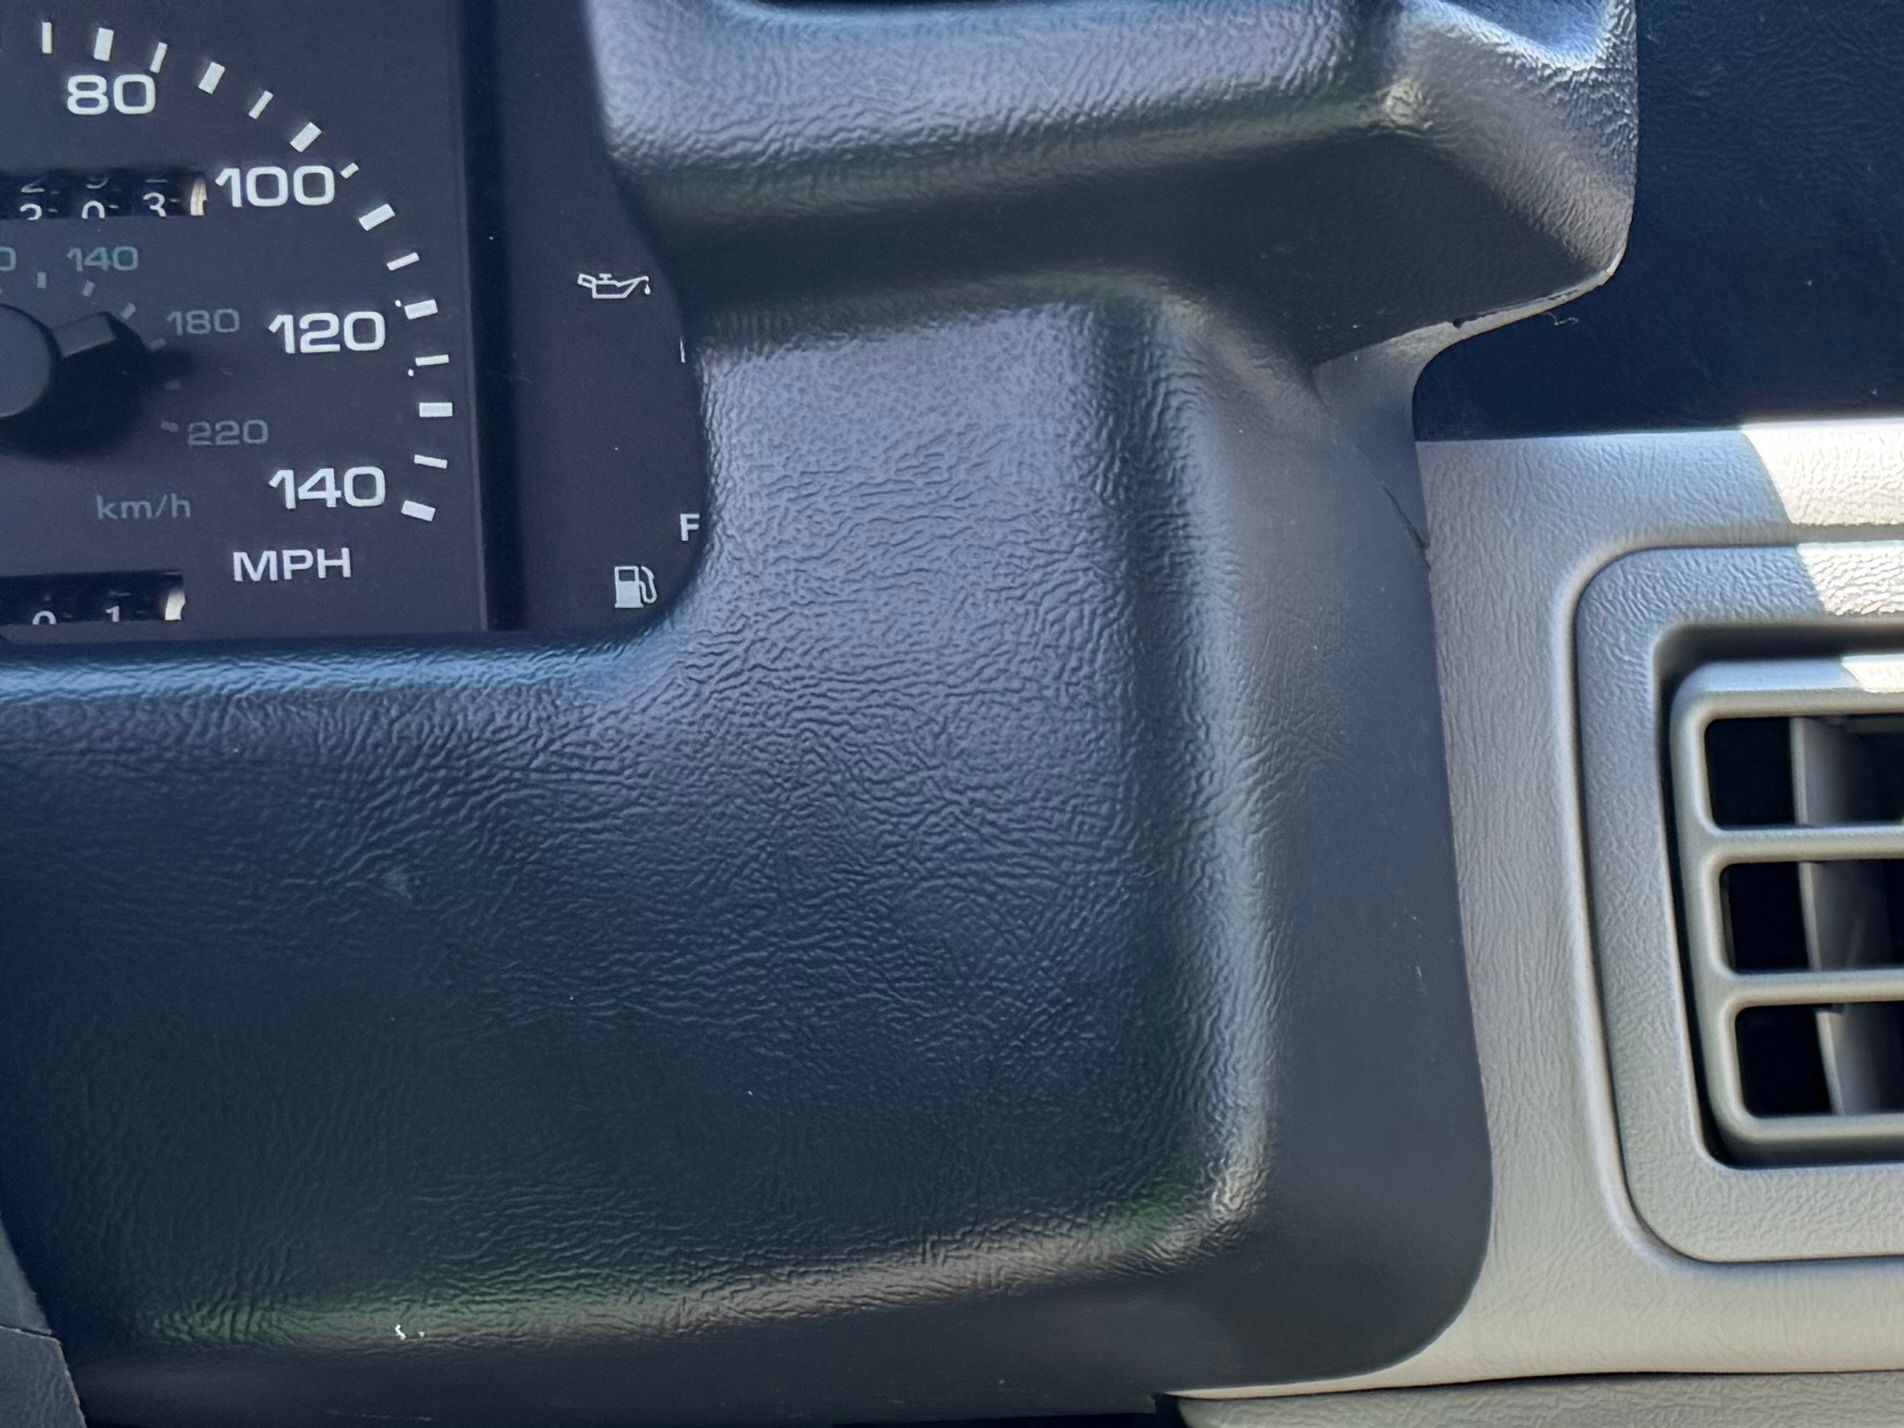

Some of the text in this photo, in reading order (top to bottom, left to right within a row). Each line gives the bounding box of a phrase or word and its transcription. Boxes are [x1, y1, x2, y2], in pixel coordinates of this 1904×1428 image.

[67, 68, 160, 114] 80
[215, 165, 334, 207] 100
[67, 246, 138, 271] 140
[167, 308, 239, 334] 180
[269, 311, 385, 353] 120
[188, 420, 268, 445] 220
[269, 466, 385, 509] 140
[96, 493, 190, 519] km/h
[680, 514, 699, 541] F
[233, 548, 351, 581] MPH
